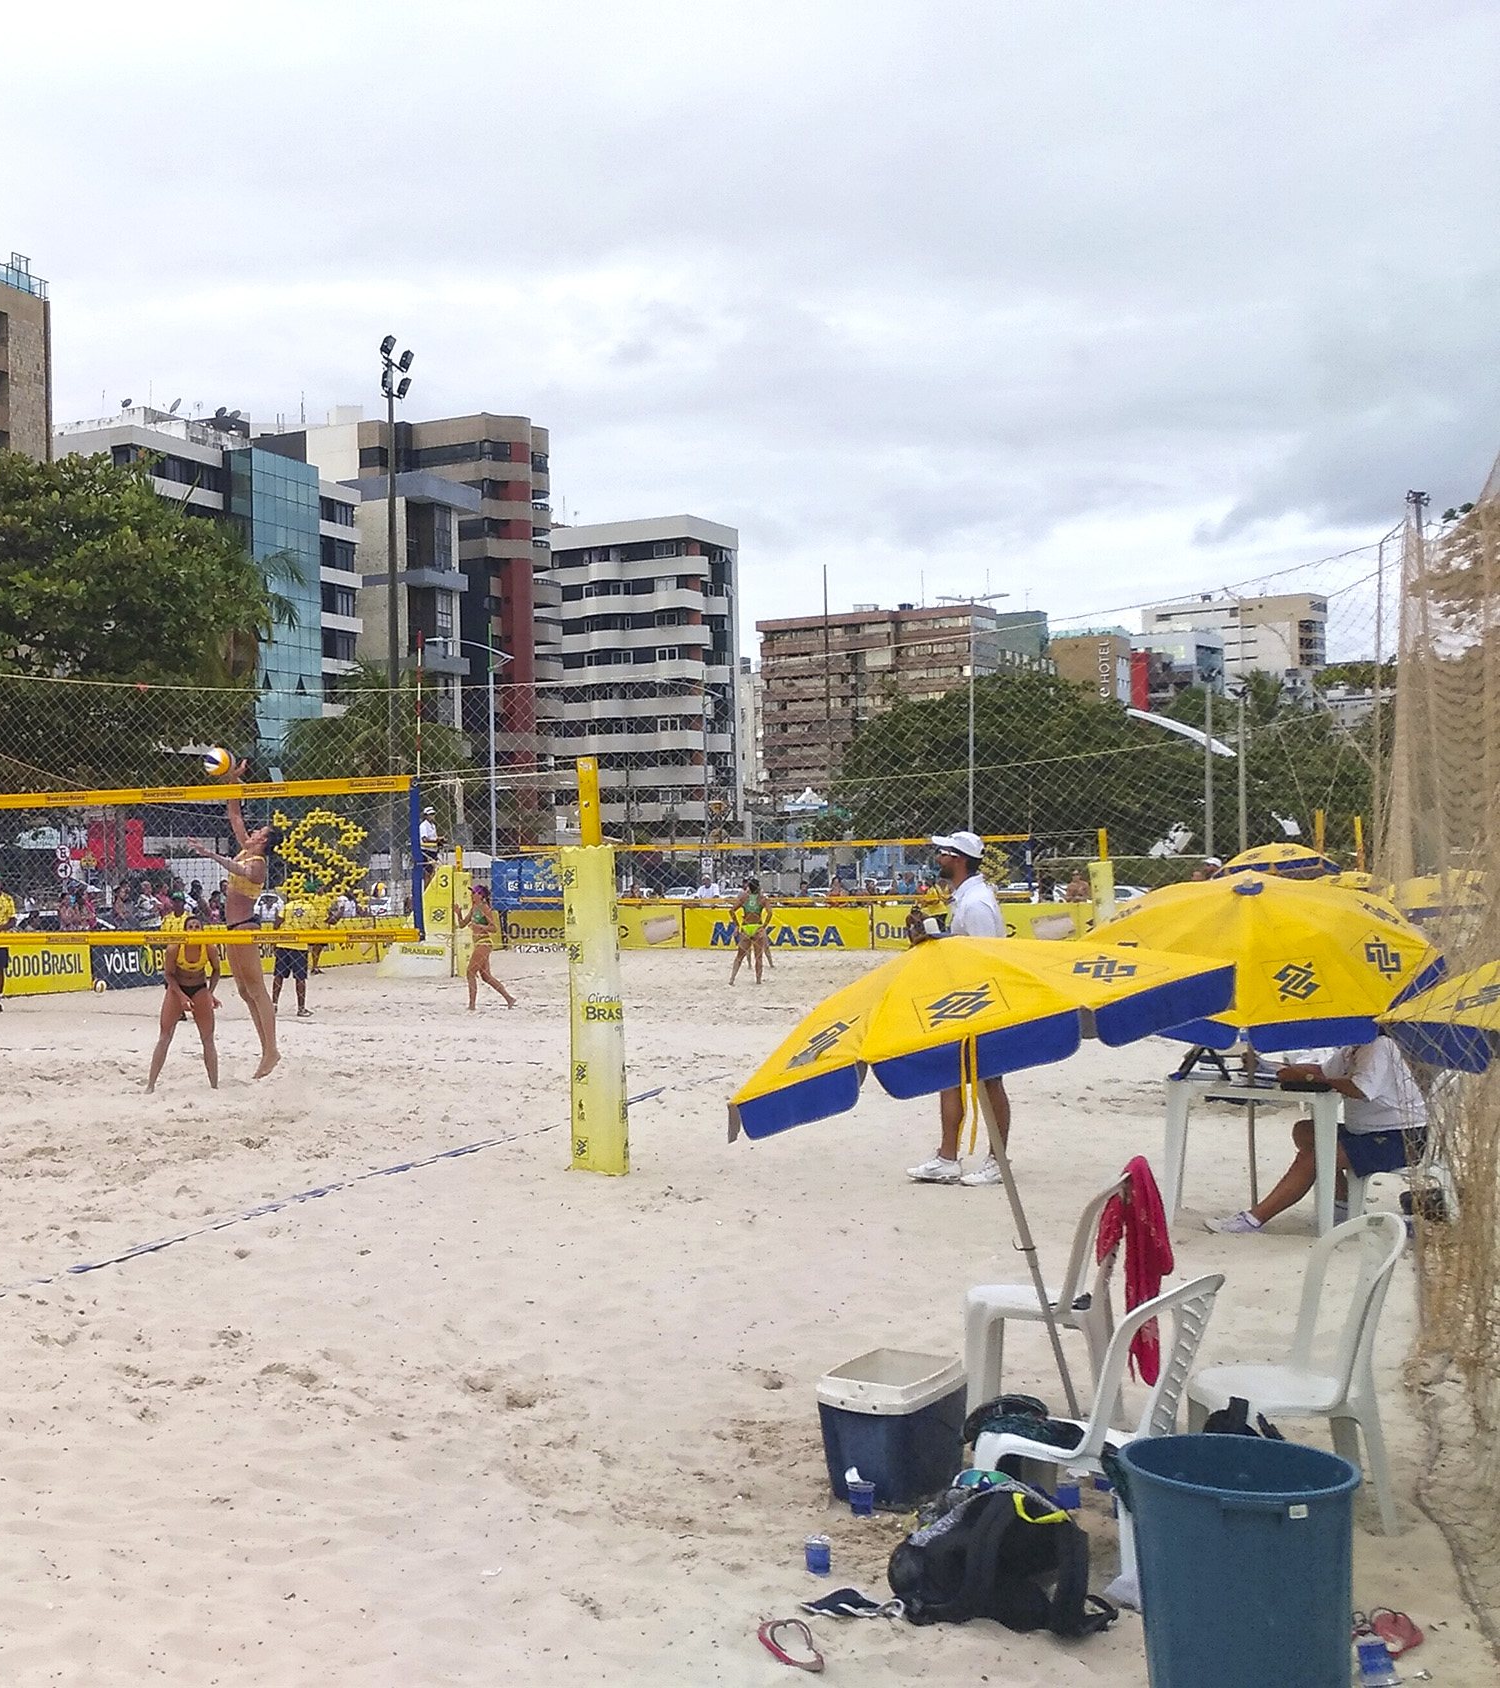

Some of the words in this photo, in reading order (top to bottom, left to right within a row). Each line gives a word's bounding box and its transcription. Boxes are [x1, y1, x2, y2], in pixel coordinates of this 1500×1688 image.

[1099, 640, 1110, 684] HOTEL
[439, 874, 449, 888] 3
[710, 921, 845, 947] MKASA
[23, 954, 39, 977] DO
[41, 950, 84, 976] BRASIL
[103, 948, 140, 974] VÔLEI
[401, 946, 444, 956] BRASILEIRO
